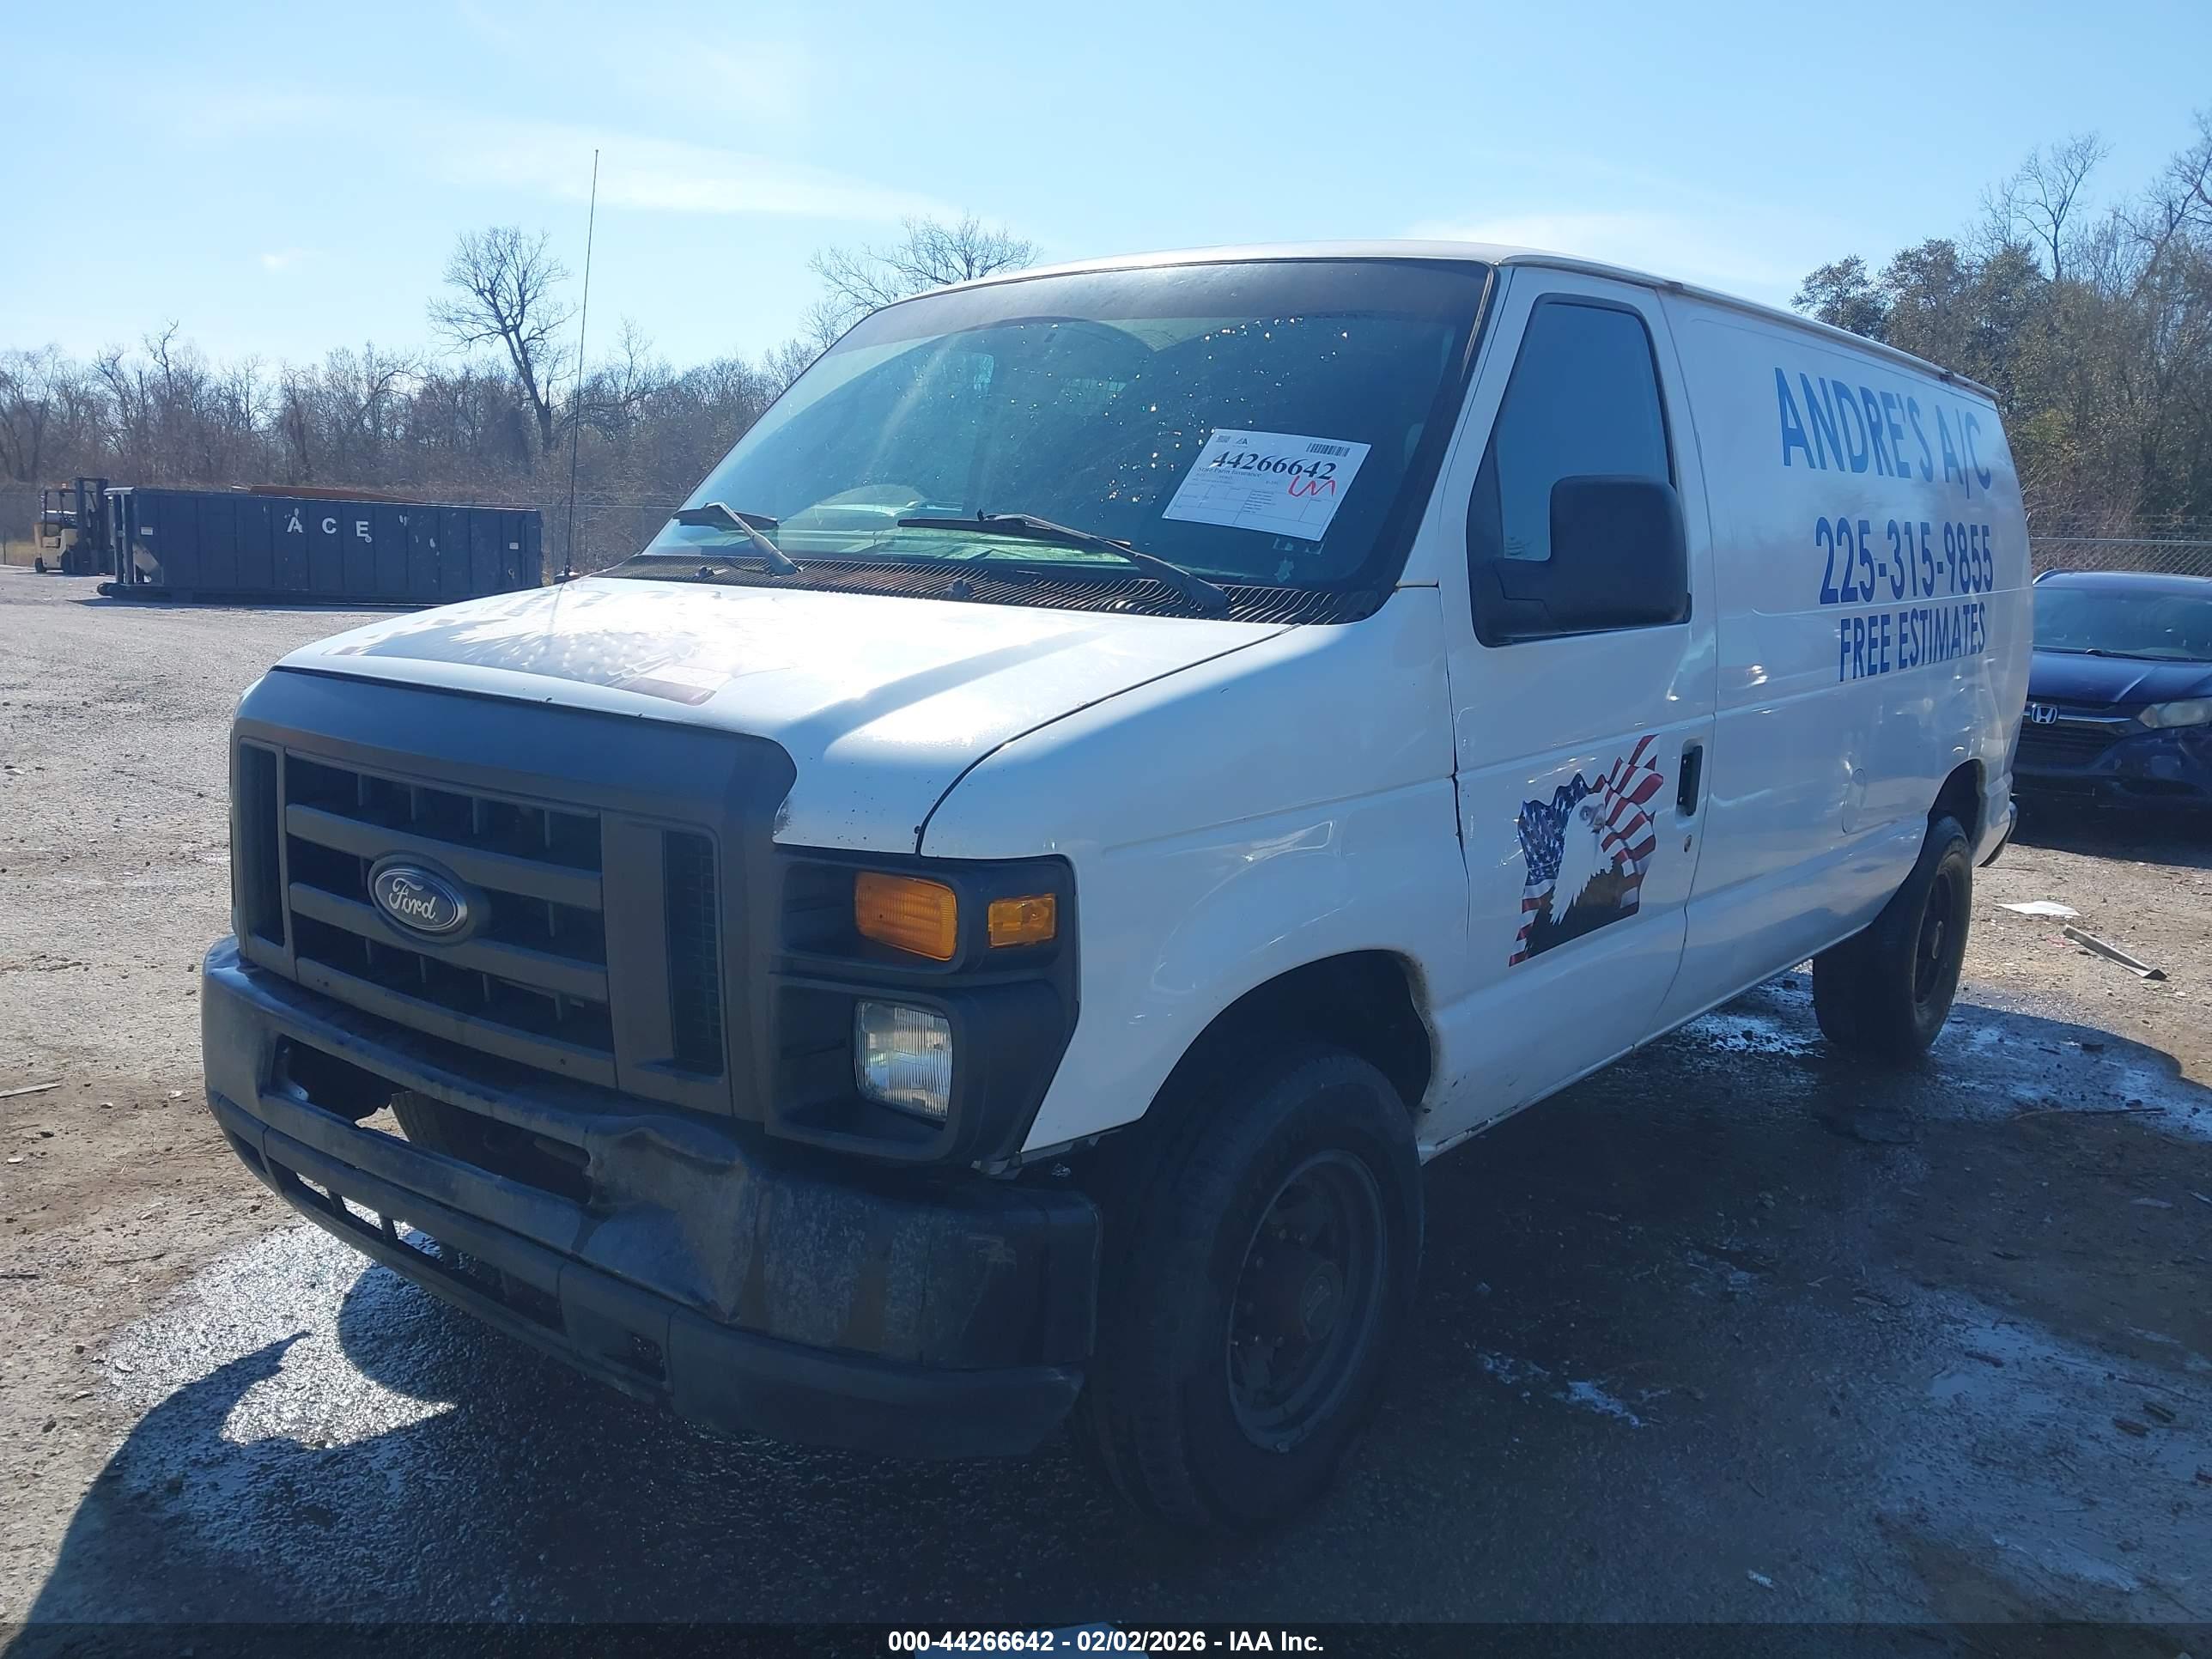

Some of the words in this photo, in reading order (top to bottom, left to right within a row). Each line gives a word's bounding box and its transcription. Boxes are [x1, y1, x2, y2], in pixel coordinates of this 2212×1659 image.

[1212, 451, 1337, 481] 44266642
[1774, 368, 1934, 483] ANDRE'S
[1934, 404, 1991, 499] A/C
[1815, 516, 1994, 605] 225-315-9855
[1839, 614, 1891, 683] FREE
[1898, 602, 1986, 670] ESTIMATES
[388, 878, 436, 921] Ford
